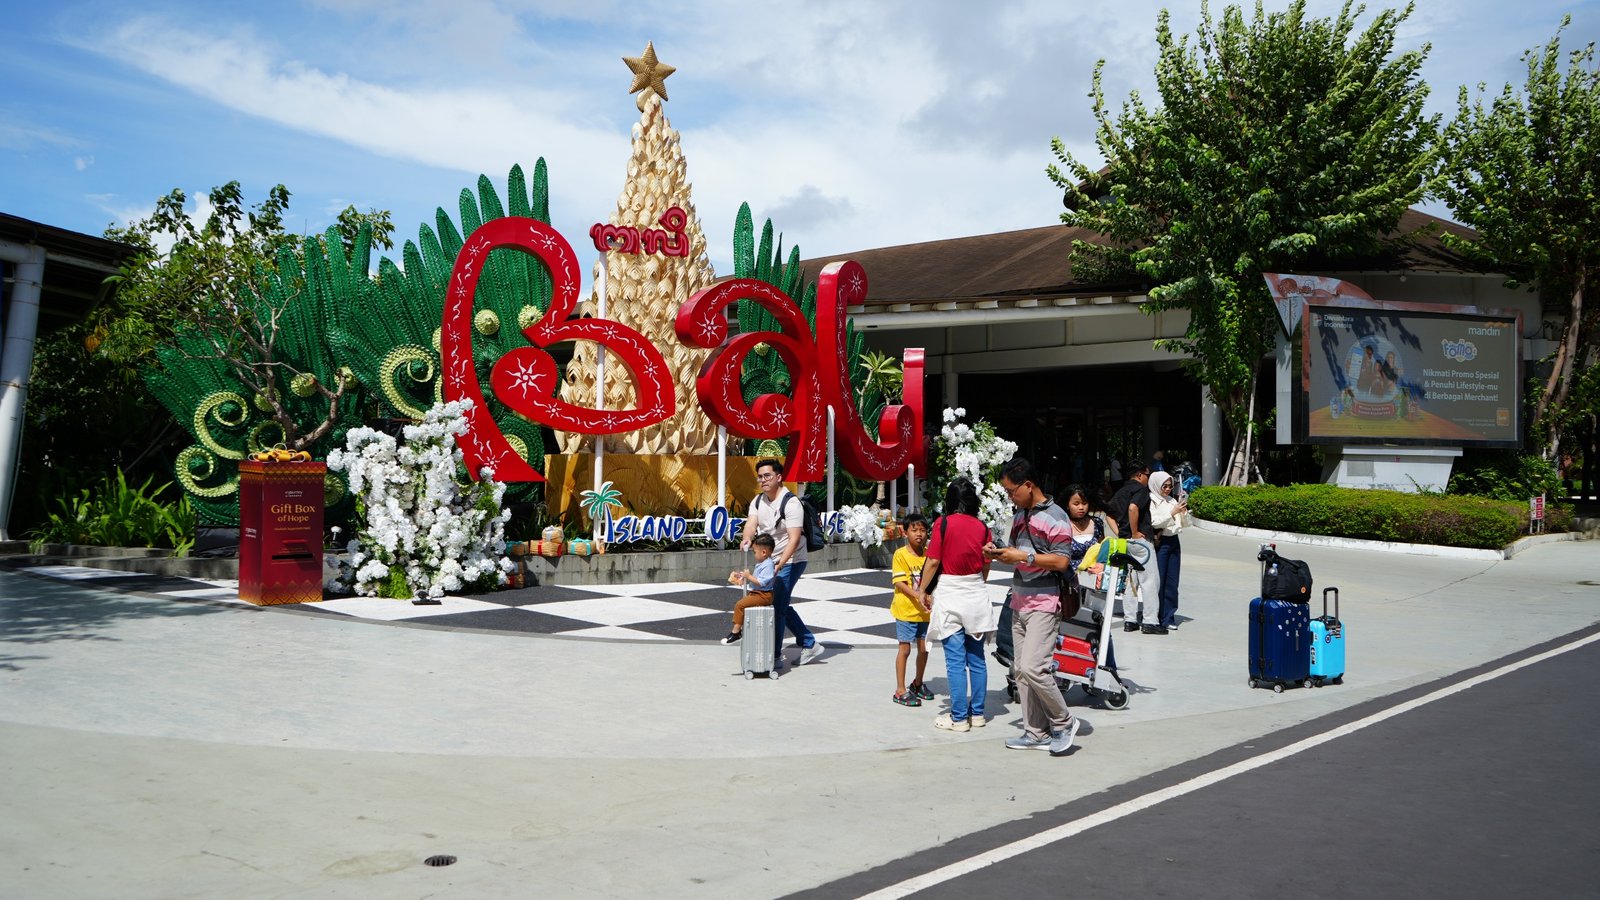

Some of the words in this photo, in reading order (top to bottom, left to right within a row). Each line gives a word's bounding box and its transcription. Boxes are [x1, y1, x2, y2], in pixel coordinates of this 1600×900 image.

[1422, 368, 1451, 378] Nikmati
[1451, 369, 1474, 379] Promo
[1475, 371, 1500, 381] Spesial
[1423, 380, 1430, 388] &
[1431, 380, 1455, 389] Penuhi
[1456, 381, 1498, 391] Lifestyle-mu
[1424, 391, 1431, 400] di
[1432, 391, 1464, 402] Berbagai
[270, 503, 292, 513] Gift
[295, 503, 316, 513] Box
[277, 514, 287, 522] of
[287, 514, 309, 523] Hope
